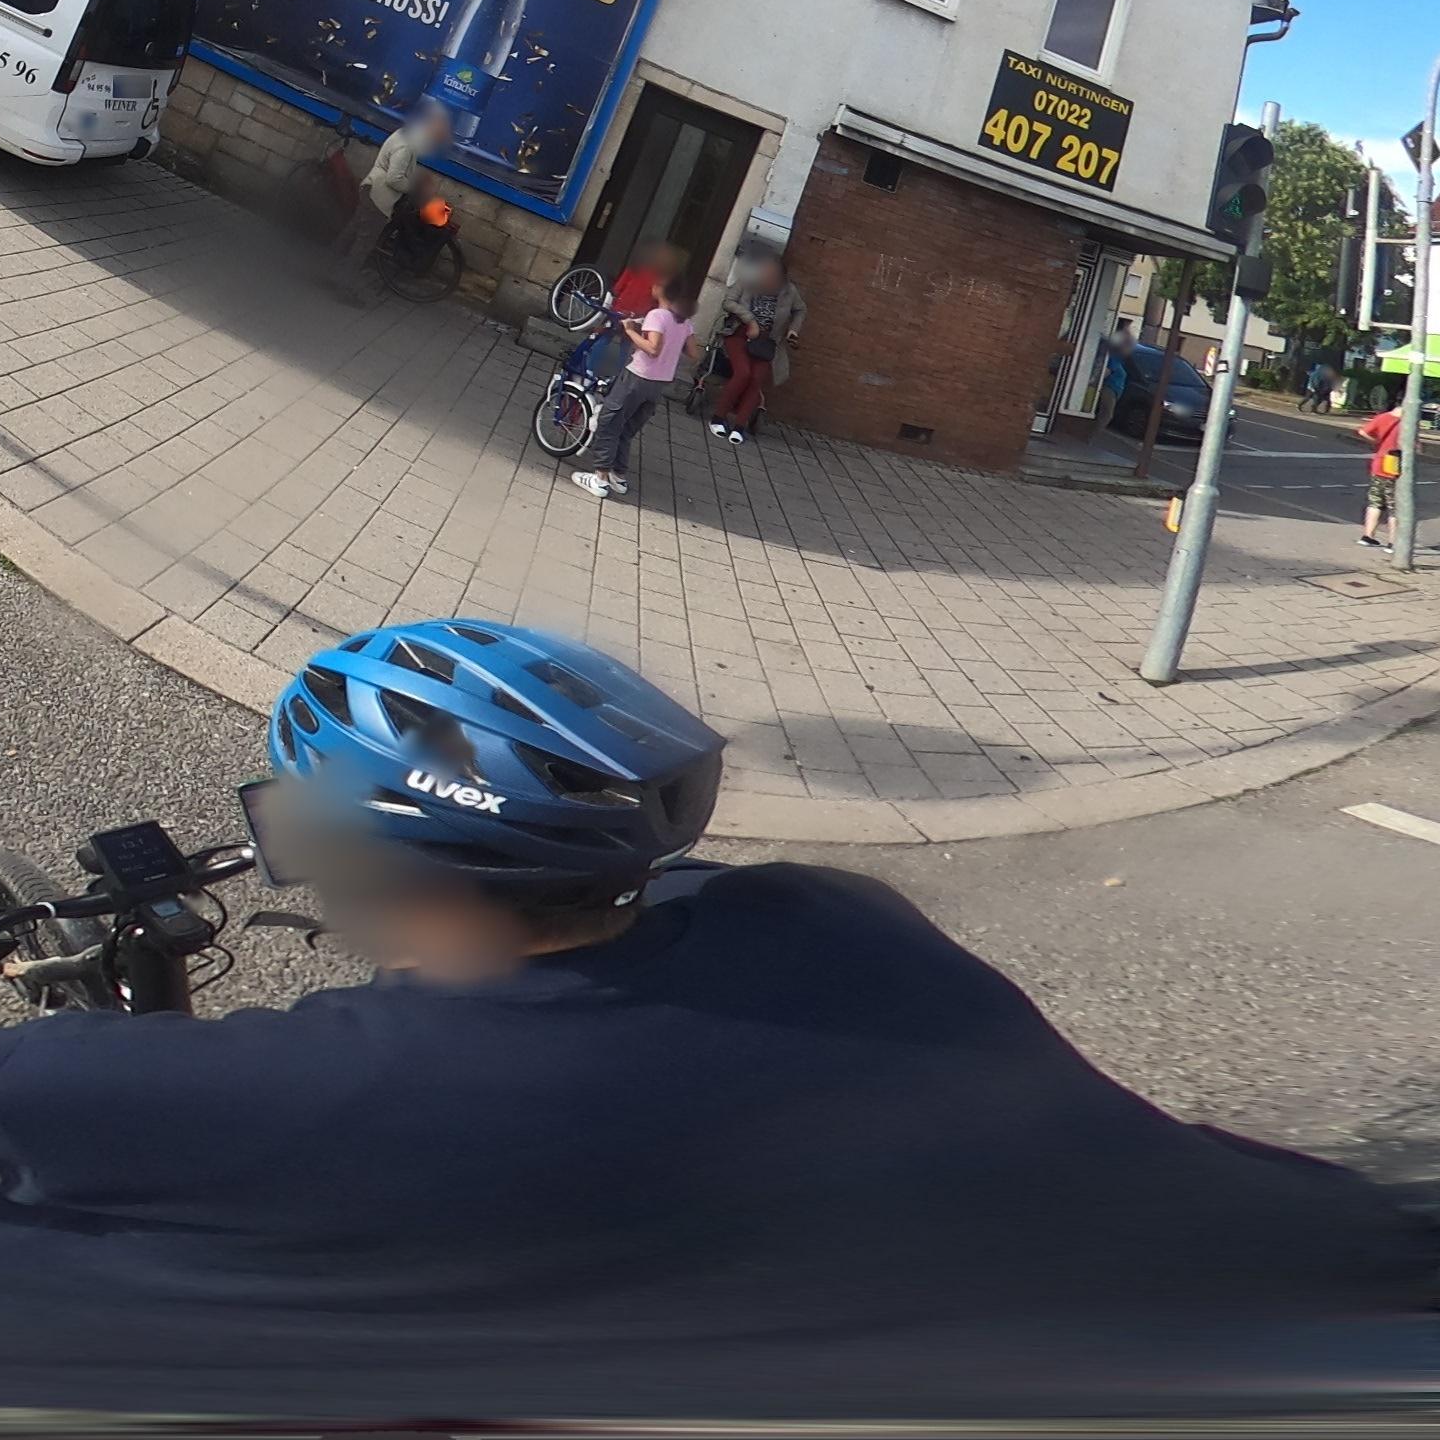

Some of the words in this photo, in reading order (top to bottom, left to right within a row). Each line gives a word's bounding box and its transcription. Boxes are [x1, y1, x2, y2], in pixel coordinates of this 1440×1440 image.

[12, 60, 39, 85] 96
[1007, 56, 1043, 80] TAXI
[105, 99, 137, 112] WEINER
[1033, 90, 1092, 130] 07022
[984, 108, 1052, 160] 407
[1055, 135, 1120, 185] 207
[406, 769, 508, 814] uvex
